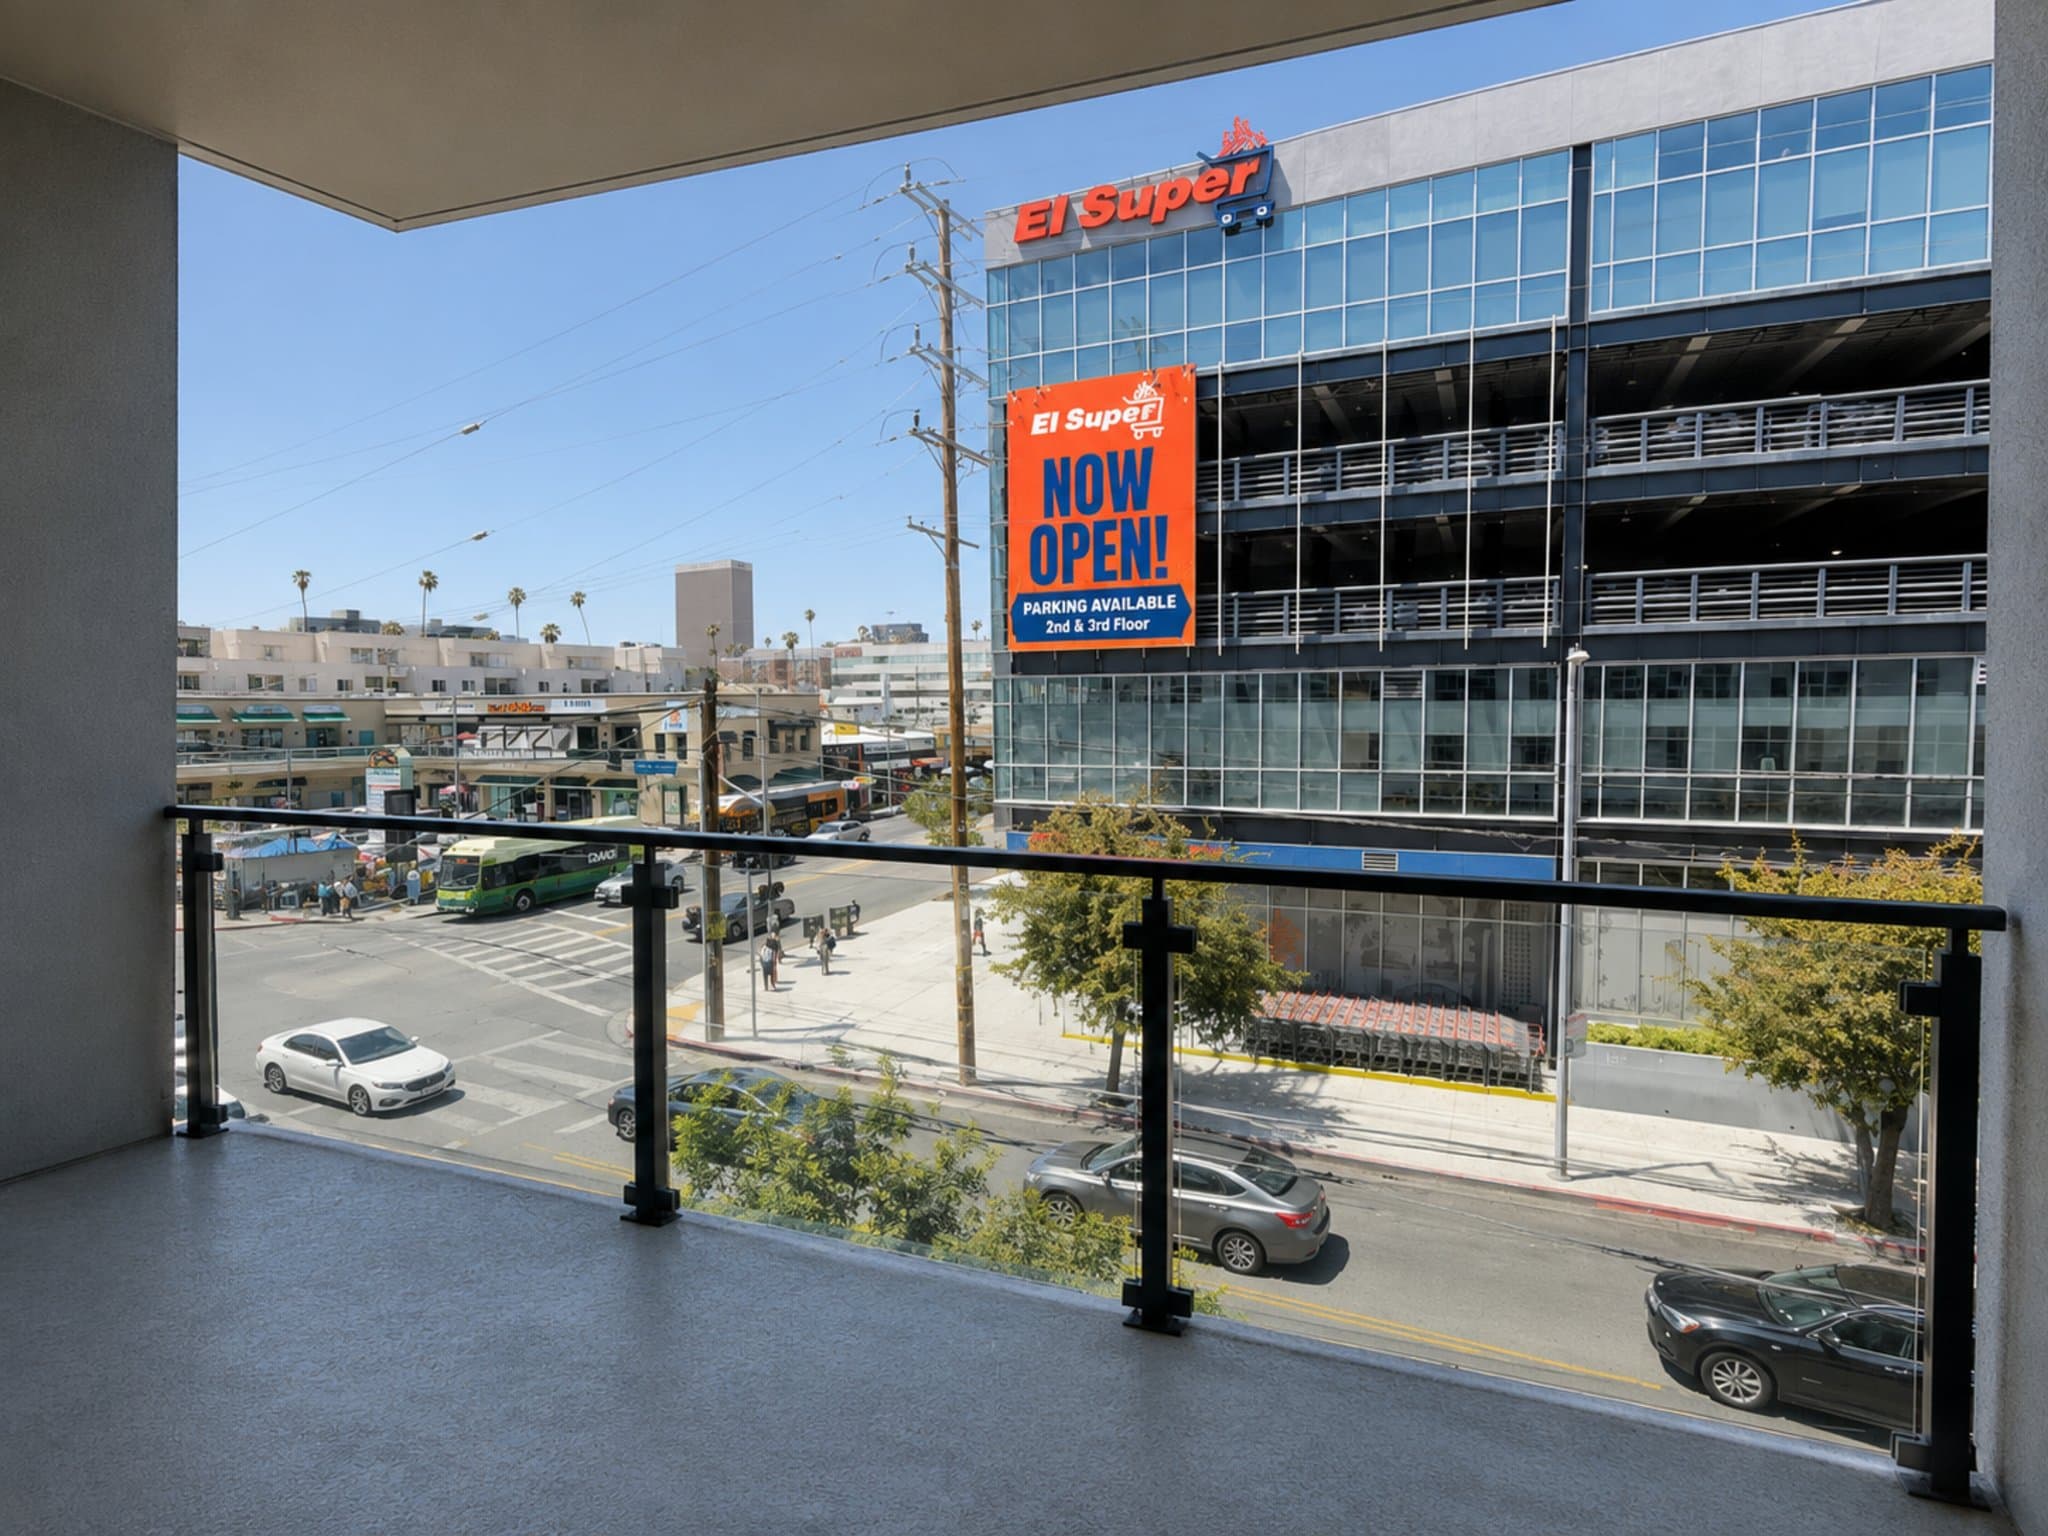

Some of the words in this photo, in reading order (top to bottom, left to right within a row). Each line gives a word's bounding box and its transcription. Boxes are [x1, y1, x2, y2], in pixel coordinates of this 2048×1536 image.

[1014, 195, 1069, 243] El
[1079, 157, 1260, 229] Super
[1031, 411, 1059, 435] El
[1064, 403, 1156, 432] Super
[1043, 446, 1154, 518] NOW
[1029, 515, 1168, 586] OPEN!
[1023, 599, 1087, 615] PARKING
[1091, 594, 1177, 612] AVAILABLE
[1046, 620, 1070, 633] 2nd
[1074, 619, 1084, 632] &
[1087, 618, 1111, 632] 3rd
[1114, 617, 1151, 631] Floor
